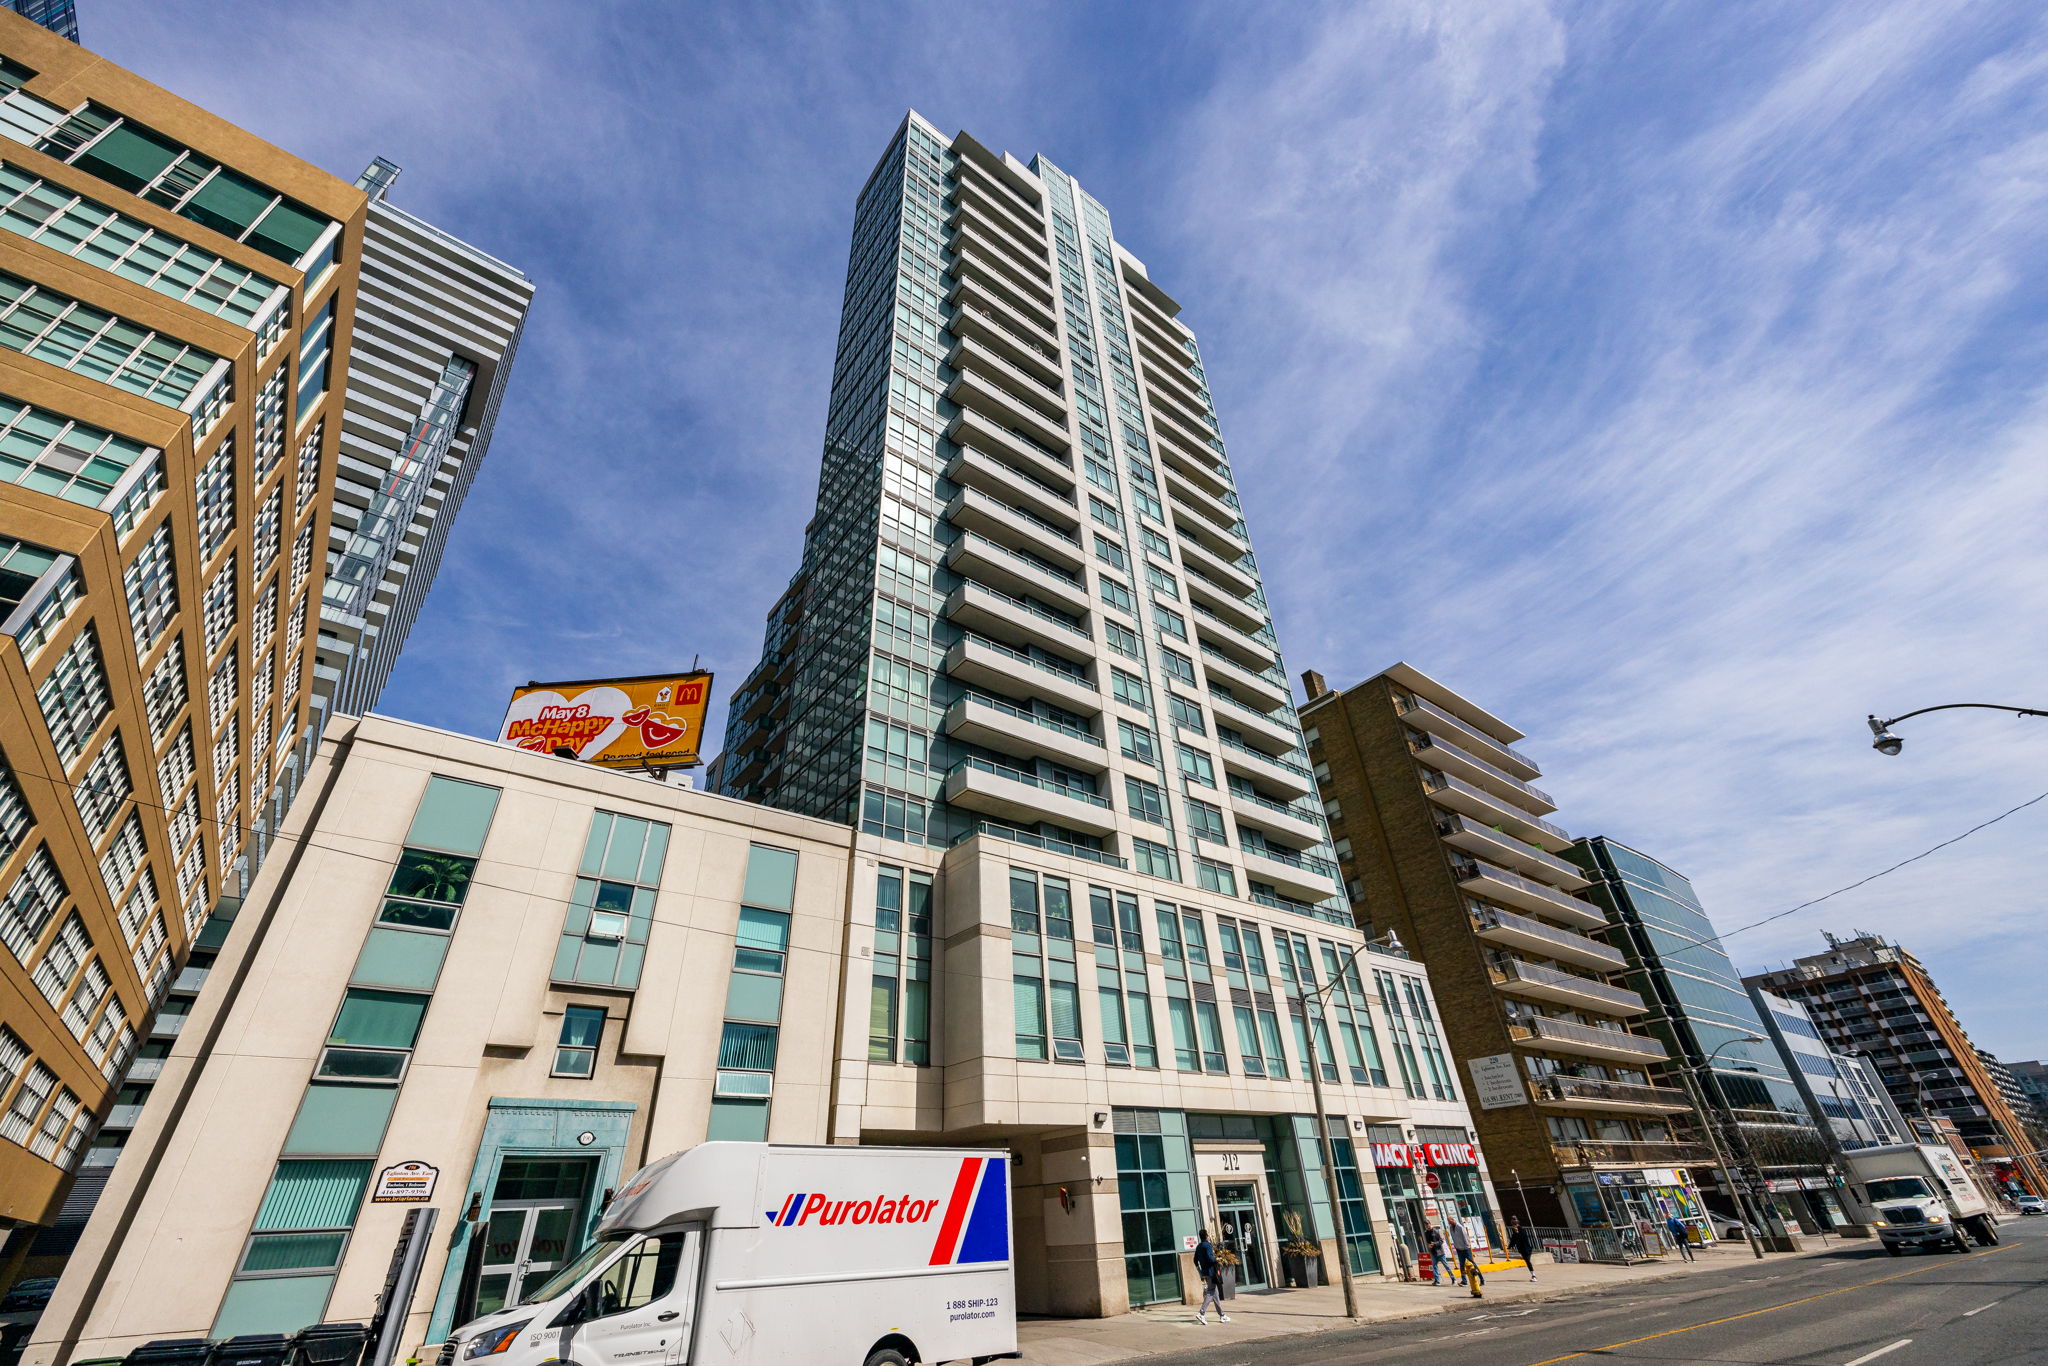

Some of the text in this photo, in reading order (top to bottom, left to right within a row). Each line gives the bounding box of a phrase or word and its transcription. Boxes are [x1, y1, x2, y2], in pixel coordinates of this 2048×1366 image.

[540, 705, 589, 721] May 8
[509, 717, 613, 738] McHappy
[1222, 1153, 1240, 1170] 212
[1429, 1143, 1476, 1165] CLINIC
[798, 1193, 940, 1227] Purolator
[946, 1297, 999, 1310] 1 888 SHIP-123
[950, 1311, 996, 1323] purolator.com
[529, 1330, 560, 1342] ISO 9001
[613, 1350, 650, 1358] TRANSIT
